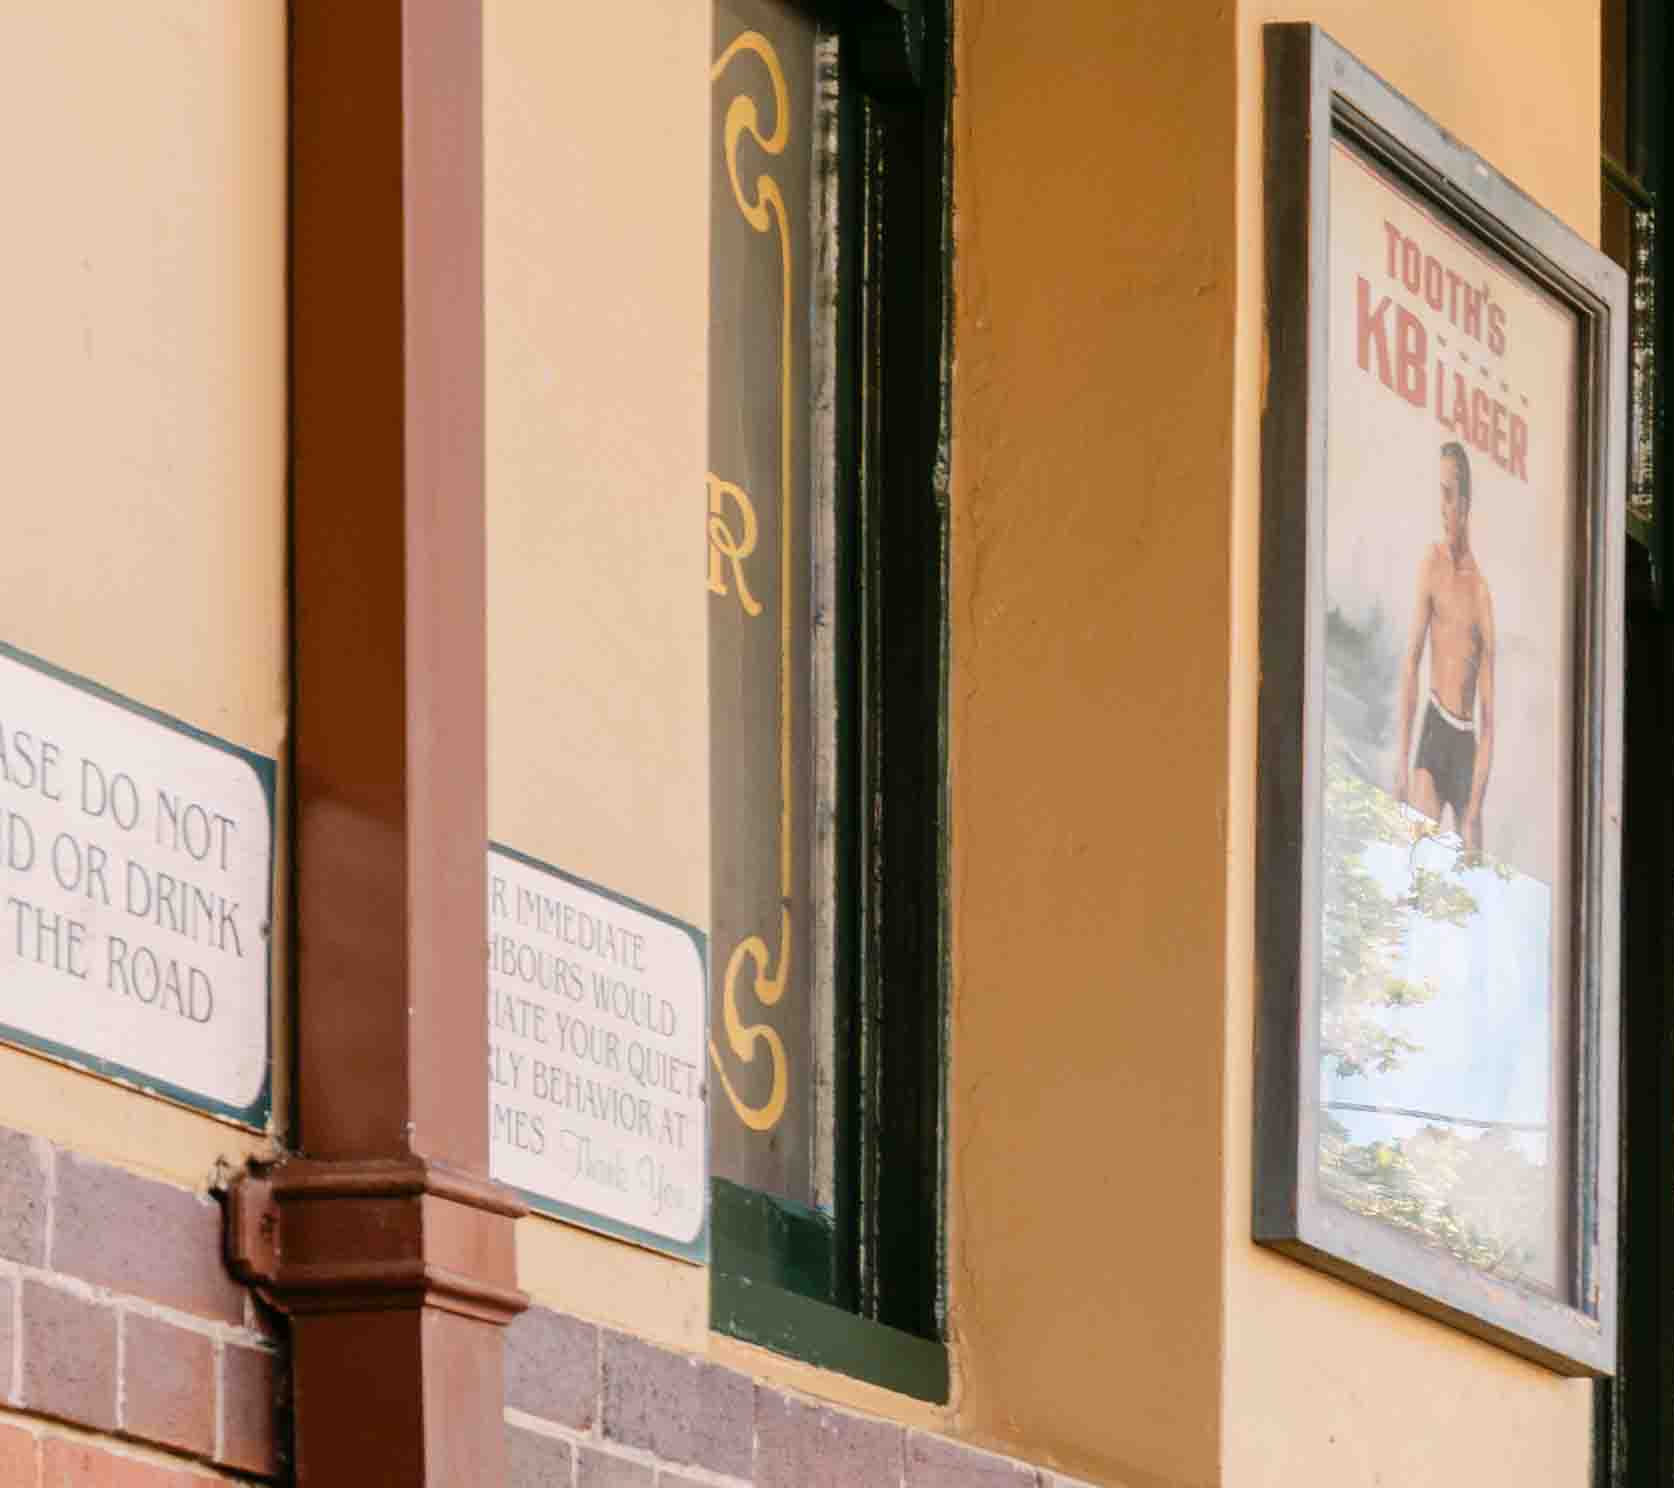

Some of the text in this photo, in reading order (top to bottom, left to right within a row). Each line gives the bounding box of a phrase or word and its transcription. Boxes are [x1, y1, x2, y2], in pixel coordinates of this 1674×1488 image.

[1381, 218, 1507, 357] TOOTH'S
[1357, 272, 1529, 485] KB LAGER
[80, 758, 139, 832] DO
[155, 786, 238, 872] NOT
[51, 833, 111, 906] OR
[124, 859, 243, 958] DRINK
[515, 883, 647, 973] IMMEDIATE
[5, 896, 215, 1024] THE ROAD
[591, 970, 677, 1038] WOULD
[532, 1059, 653, 1138] BEHAVIOR
[659, 1104, 688, 1150] AT
[555, 1011, 620, 1069] YOUR
[627, 1040, 698, 1100] QUIET
[559, 1128, 630, 1193] Thank
